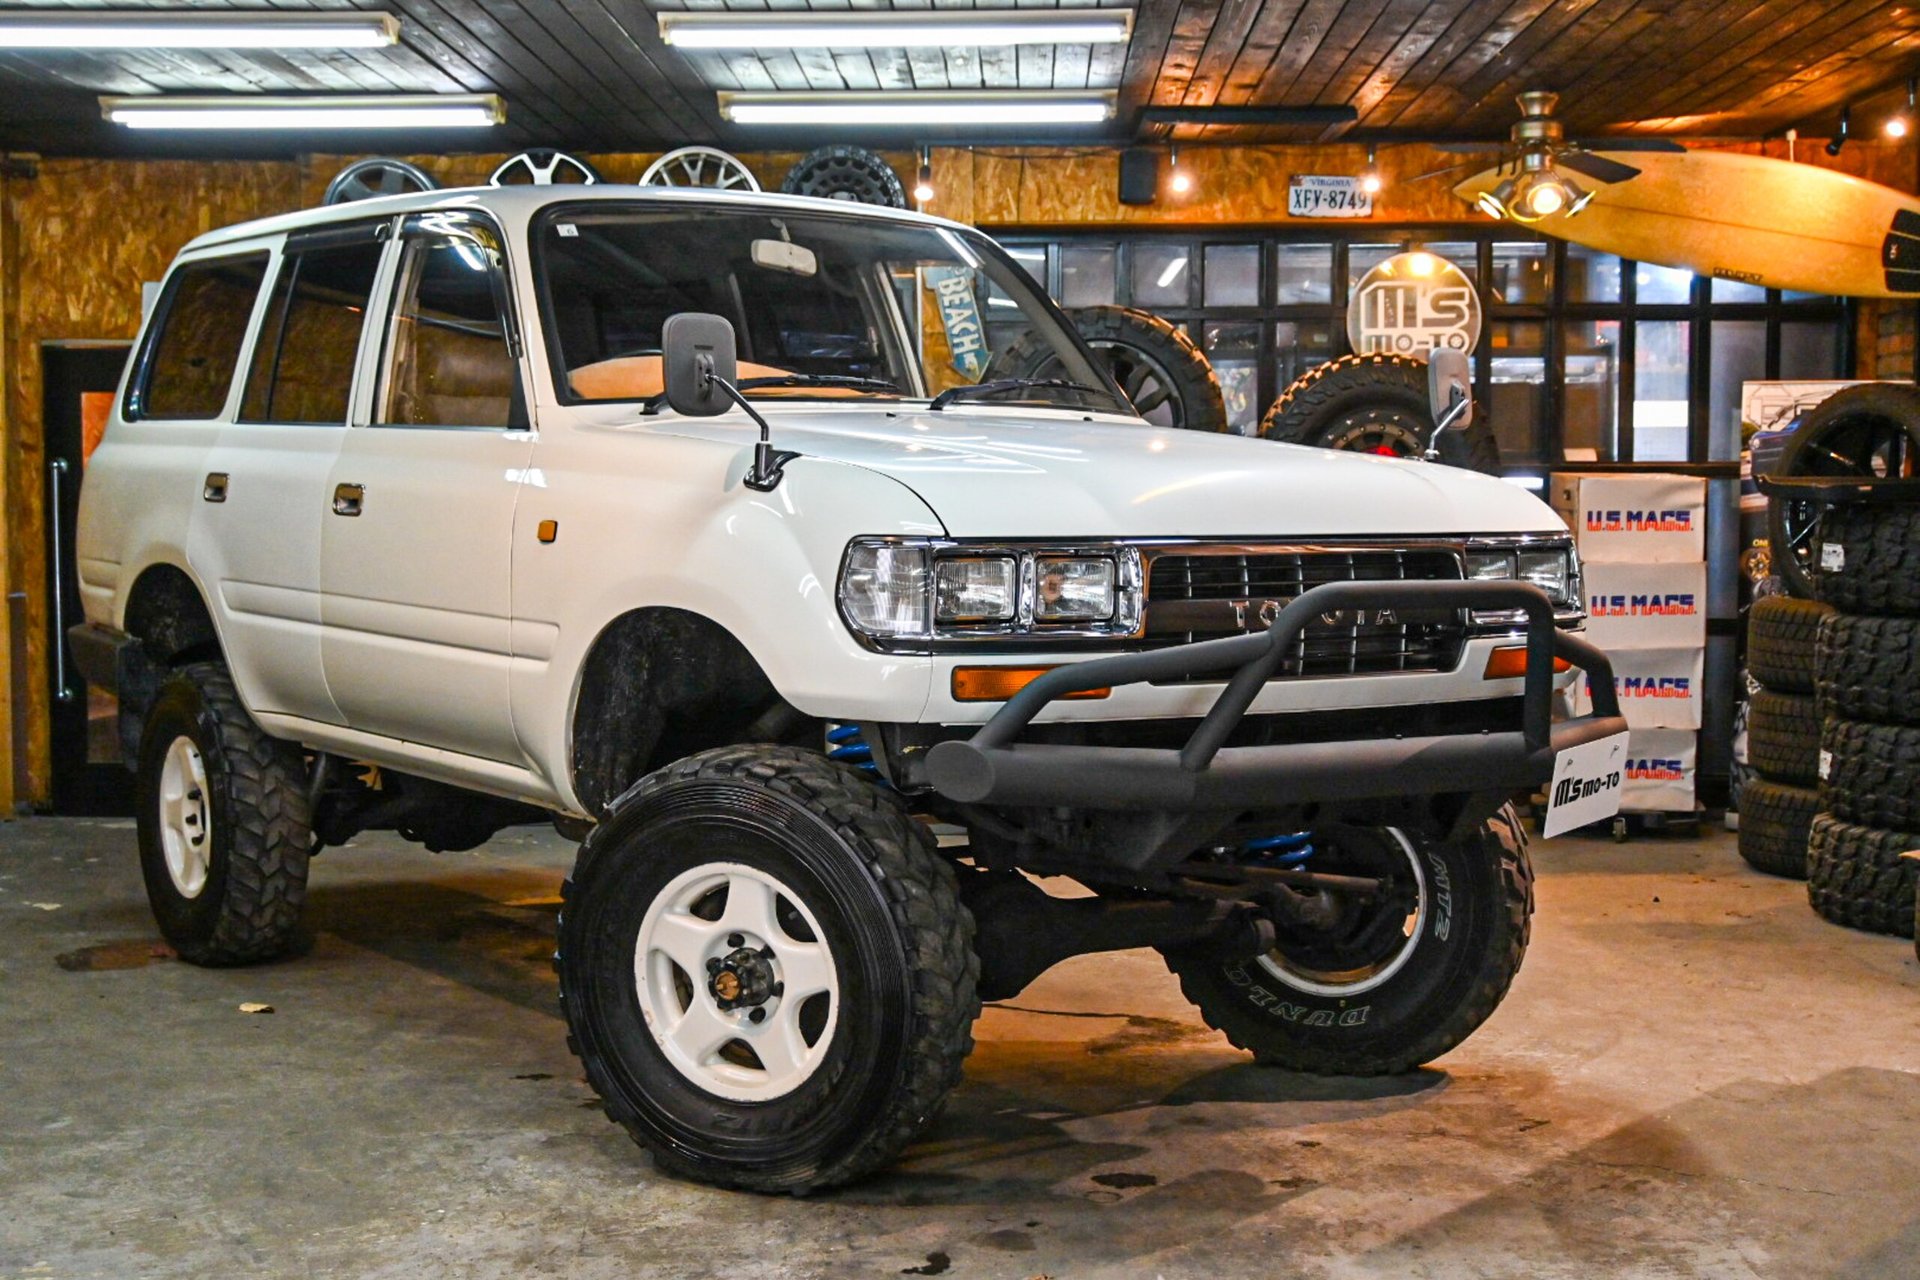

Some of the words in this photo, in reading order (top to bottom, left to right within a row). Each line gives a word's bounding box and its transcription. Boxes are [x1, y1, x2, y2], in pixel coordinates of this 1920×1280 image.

[1310, 179, 1351, 187] VIRGINIA
[1293, 188, 1367, 210] XFV-8749
[938, 276, 981, 355] BEACH
[1587, 510, 1624, 532] U.S.
[1592, 595, 1629, 616] U.S.
